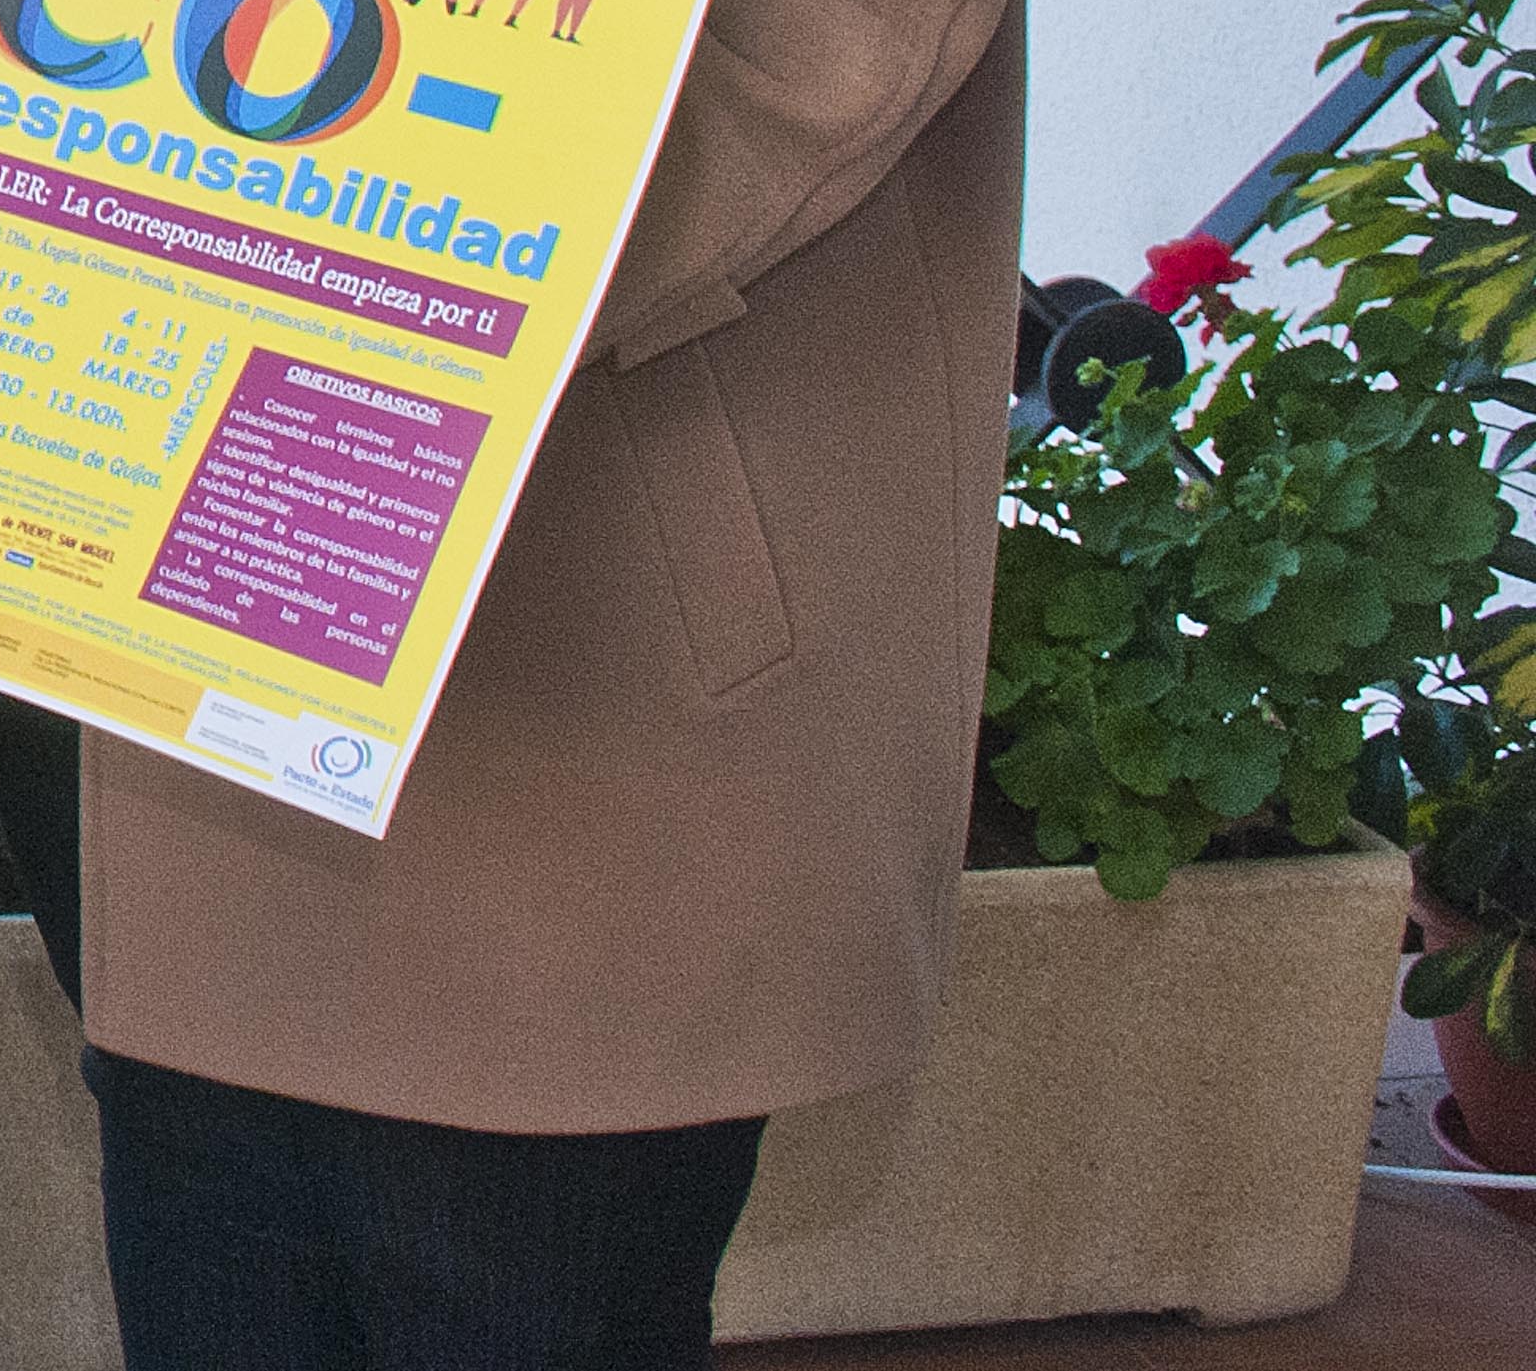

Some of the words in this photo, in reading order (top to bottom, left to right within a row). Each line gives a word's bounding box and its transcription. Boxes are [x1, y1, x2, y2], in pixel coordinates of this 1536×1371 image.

[59, 185, 90, 218] La
[95, 197, 320, 283] Corresponsabilidad
[321, 269, 421, 313] empieza
[421, 298, 473, 327] por
[475, 308, 498, 335] ti
[1, 304, 34, 327] de
[101, 332, 128, 355] 18
[147, 346, 179, 370] 25
[40, 283, 68, 307] 26
[119, 307, 137, 326] 4
[160, 317, 186, 342] 11
[81, 358, 170, 398] MARZO
[285, 364, 372, 404] OBJETIVOS
[9, 423, 79, 460] Escuelas
[80, 449, 105, 469] de
